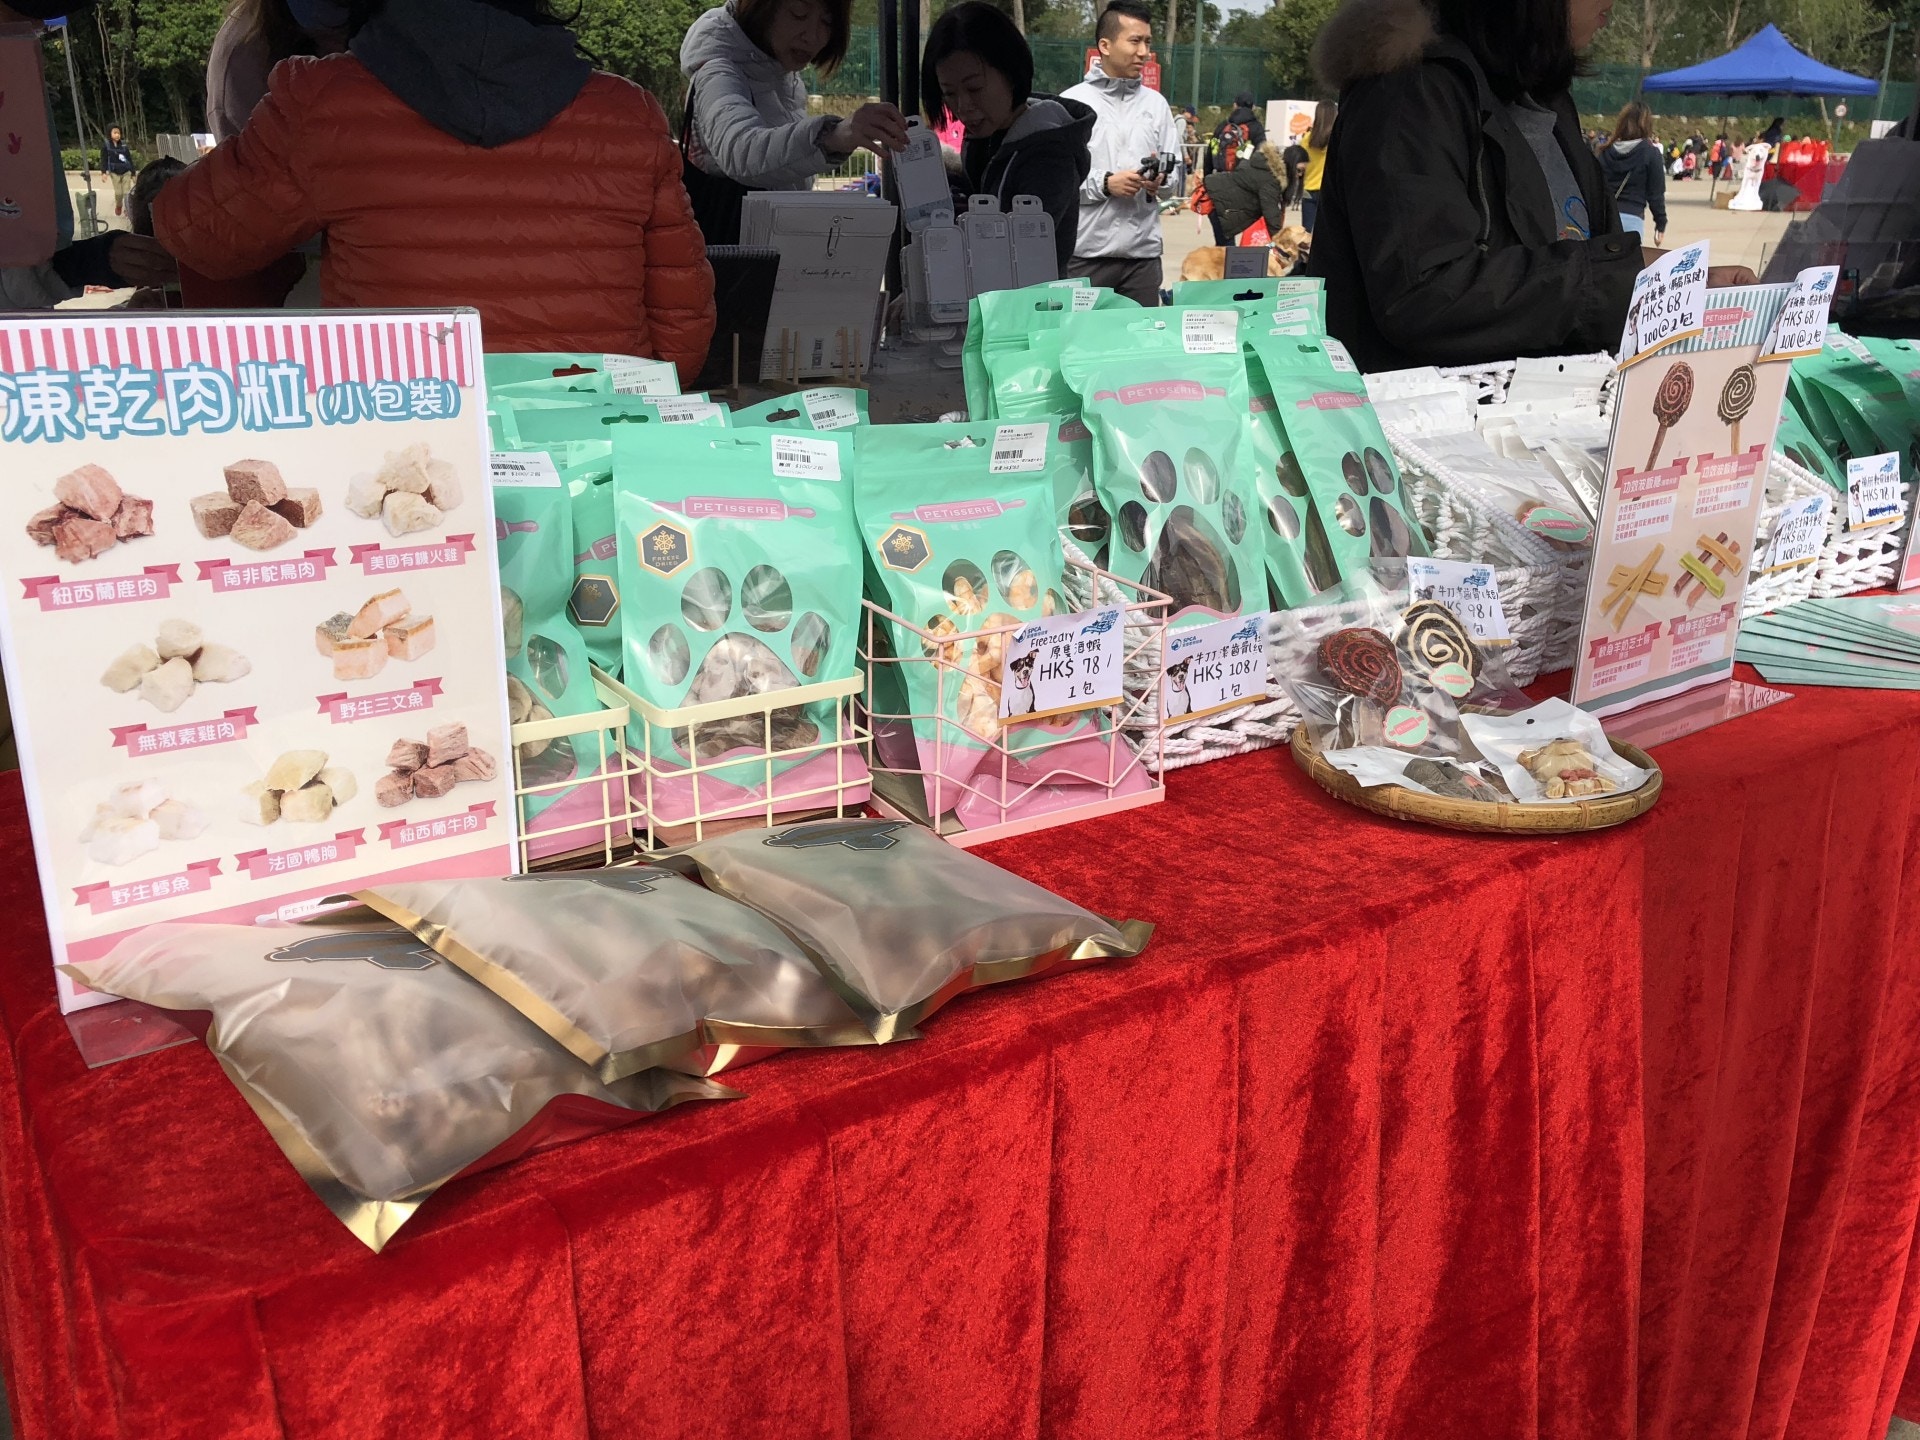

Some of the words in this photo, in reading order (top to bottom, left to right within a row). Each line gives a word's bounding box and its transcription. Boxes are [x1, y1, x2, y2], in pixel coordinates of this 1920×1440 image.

[1642, 299, 1663, 325] HK$
[1782, 309, 1803, 327] HK$
[1126, 386, 1199, 400] PETISSERIE
[693, 502, 778, 515] PETISSERIE
[1862, 489, 1878, 503] HK$
[924, 504, 995, 519] PETISSERIE
[369, 547, 459, 571] 美國有機火雞
[223, 561, 316, 587] 南非鴕鳥肉
[52, 580, 158, 606] 紐西蘭鹿肉
[1039, 658, 1074, 682] HK$
[1193, 662, 1223, 684] HK$
[339, 693, 424, 720] 野生三文魚
[137, 721, 236, 753] 無激素雞肉
[399, 815, 479, 844] 紐西蘭牛肉
[268, 846, 338, 872] 法國鴨胸
[111, 878, 190, 906] 野生鱈魚
